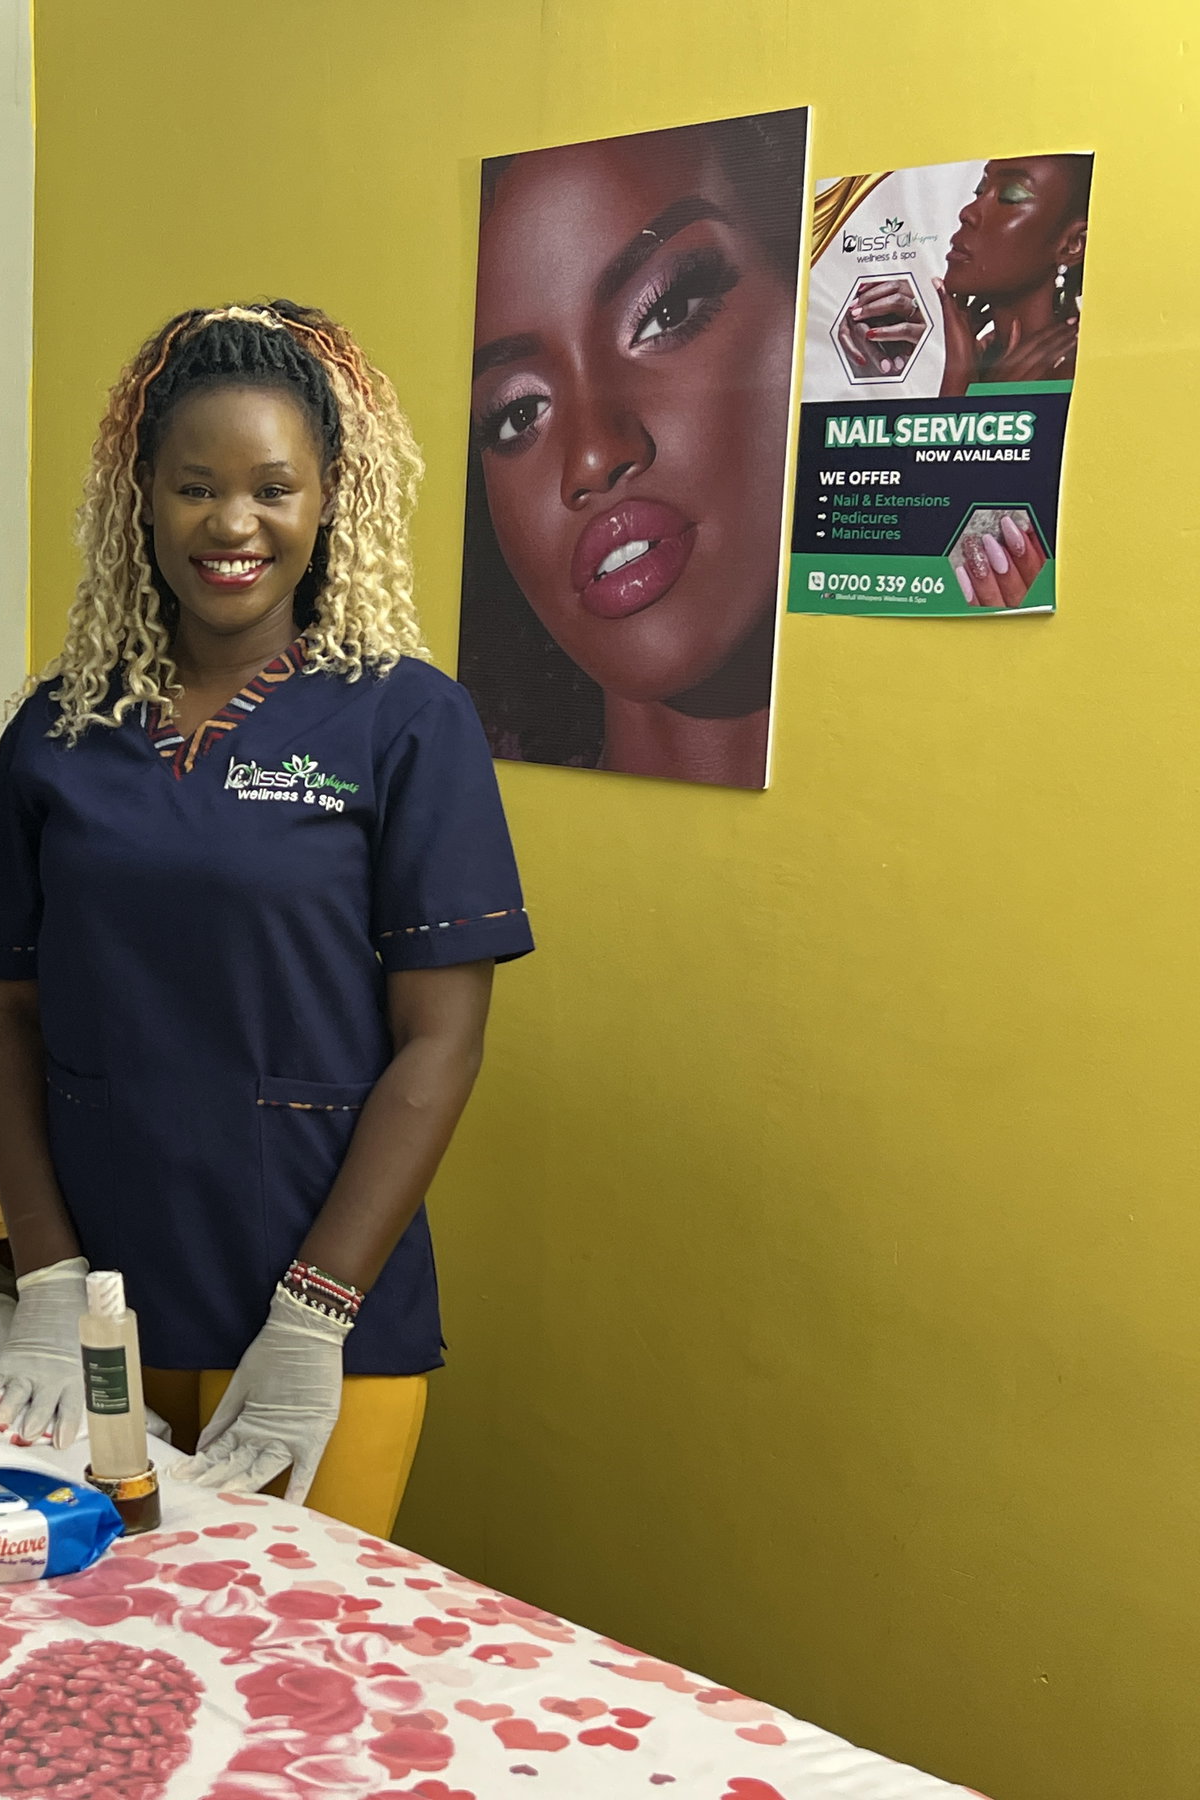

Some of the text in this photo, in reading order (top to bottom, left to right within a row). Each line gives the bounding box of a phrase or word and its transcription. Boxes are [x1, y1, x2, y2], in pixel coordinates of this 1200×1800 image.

[892, 251, 898, 261] &
[901, 251, 916, 261] spa
[826, 413, 1034, 446] NAIL SERVICES
[915, 448, 1031, 462] NOW AVAILABLE
[819, 471, 901, 485] WE OFFER
[833, 493, 951, 507] Nail & Extensions
[831, 511, 898, 525] Pedicures
[831, 526, 901, 540] Manicures
[827, 574, 945, 594] 0700 339 606
[238, 788, 345, 813] wellness & spa
